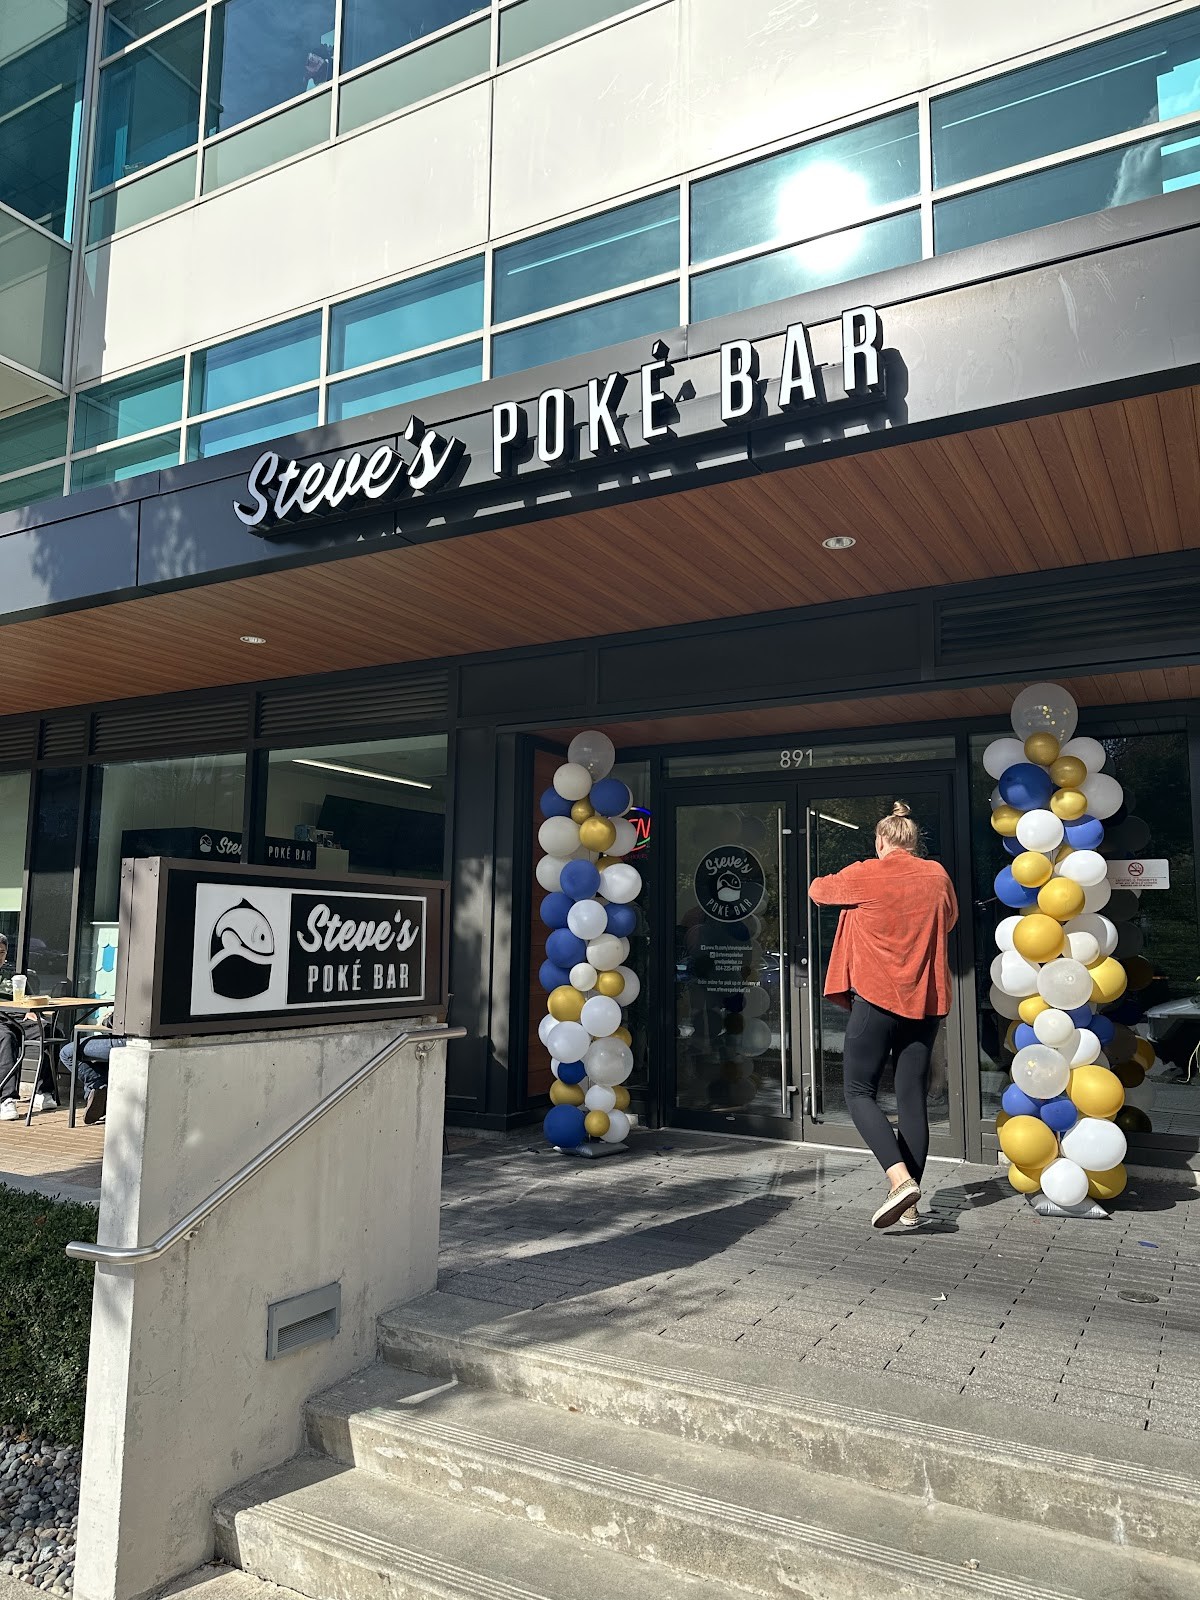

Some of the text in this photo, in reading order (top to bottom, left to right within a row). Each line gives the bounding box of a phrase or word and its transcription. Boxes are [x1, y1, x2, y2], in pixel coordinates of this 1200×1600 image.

[233, 304, 880, 526] Steve's POKÉ BAR
[779, 749, 814, 768] 891
[268, 846, 291, 860] POKÉ
[295, 849, 312, 861] BAR
[705, 855, 753, 876] Steve's
[706, 898, 753, 917] POKÉ BAR
[296, 903, 420, 953] Steve's
[307, 959, 410, 993] POKÉ BAR
